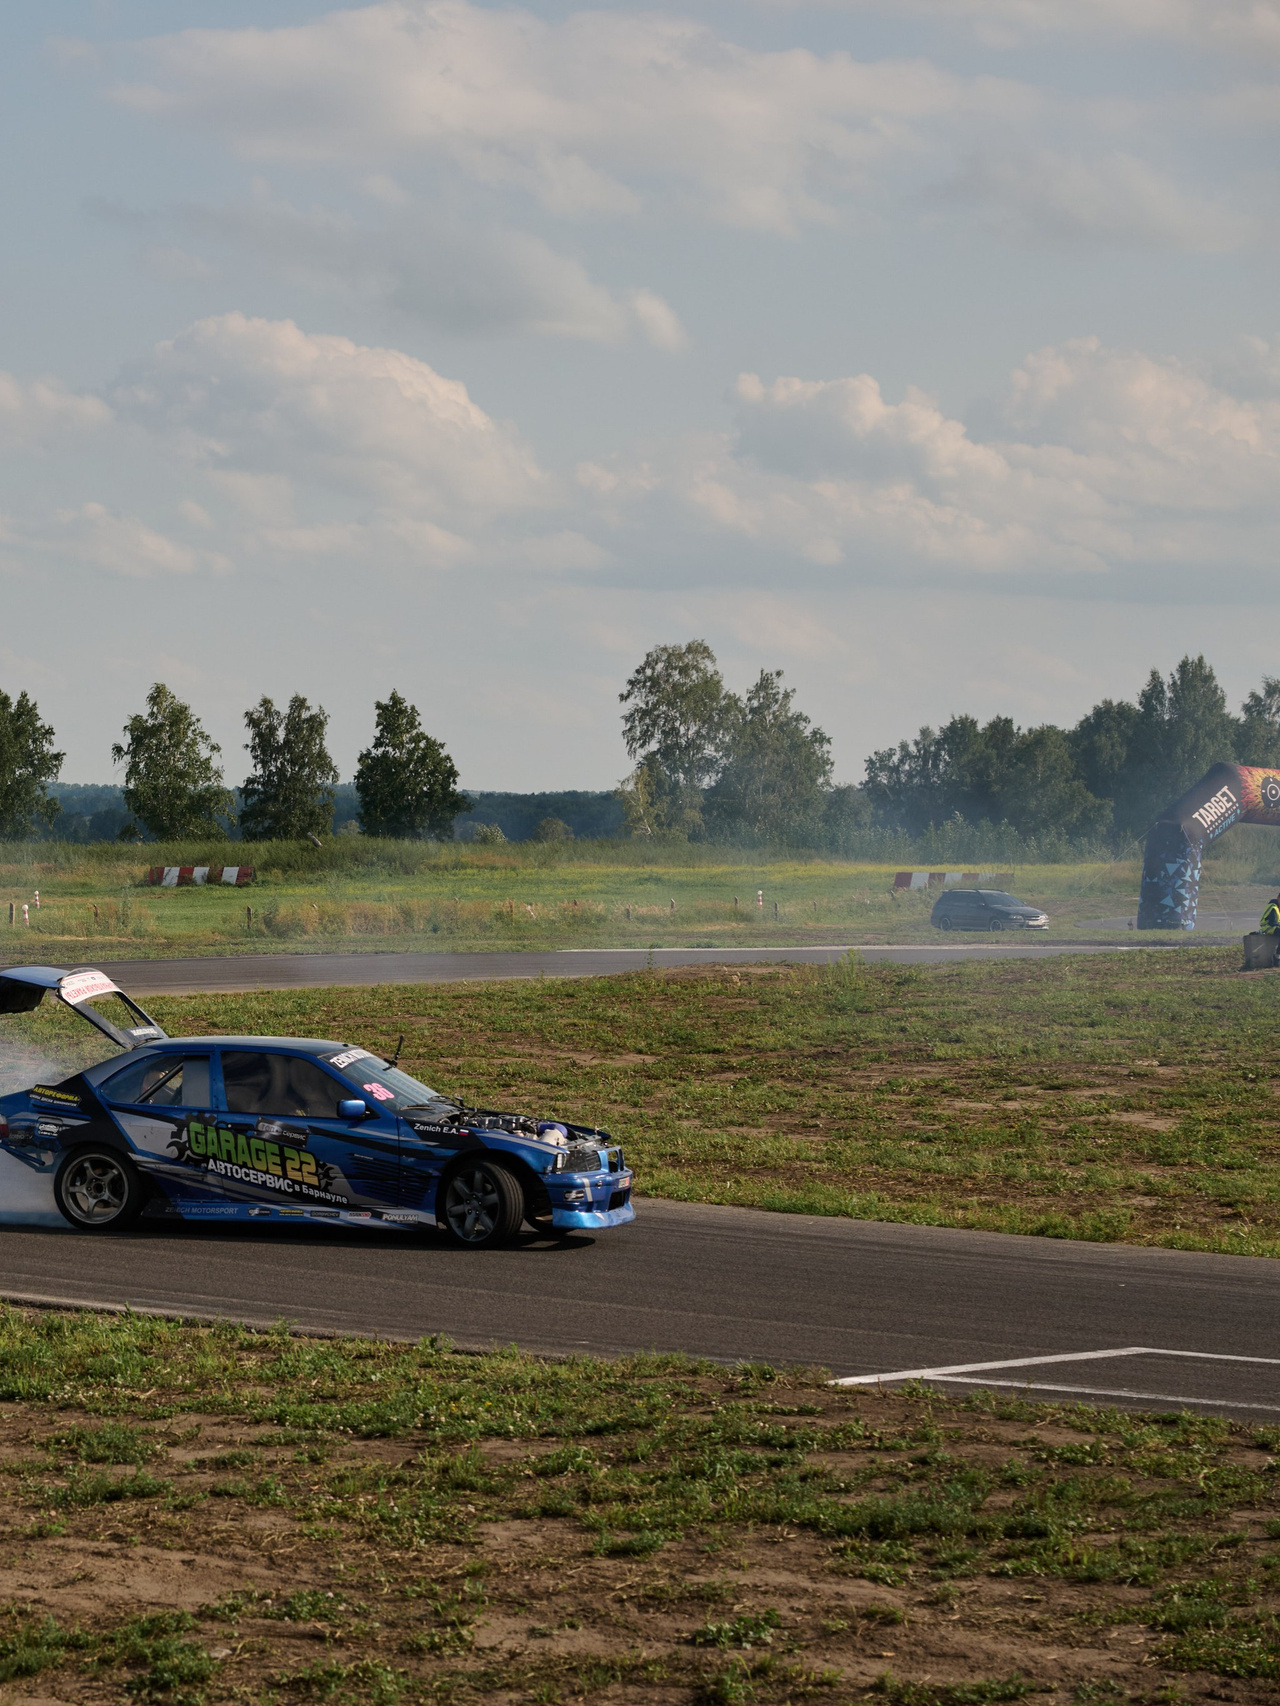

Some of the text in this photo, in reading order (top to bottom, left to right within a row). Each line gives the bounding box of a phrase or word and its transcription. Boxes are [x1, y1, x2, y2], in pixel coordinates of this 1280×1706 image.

[1192, 785, 1237, 828] TARGET
[1213, 812, 1237, 838] ACTIVE
[363, 1083, 395, 1101] 36
[414, 1123, 441, 1133] Zenich
[189, 1121, 319, 1186] GARAGE 22
[207, 1158, 348, 1204] АВТОСЕРВИС в Барнауле
[191, 1207, 239, 1215] MOTORSPORT
